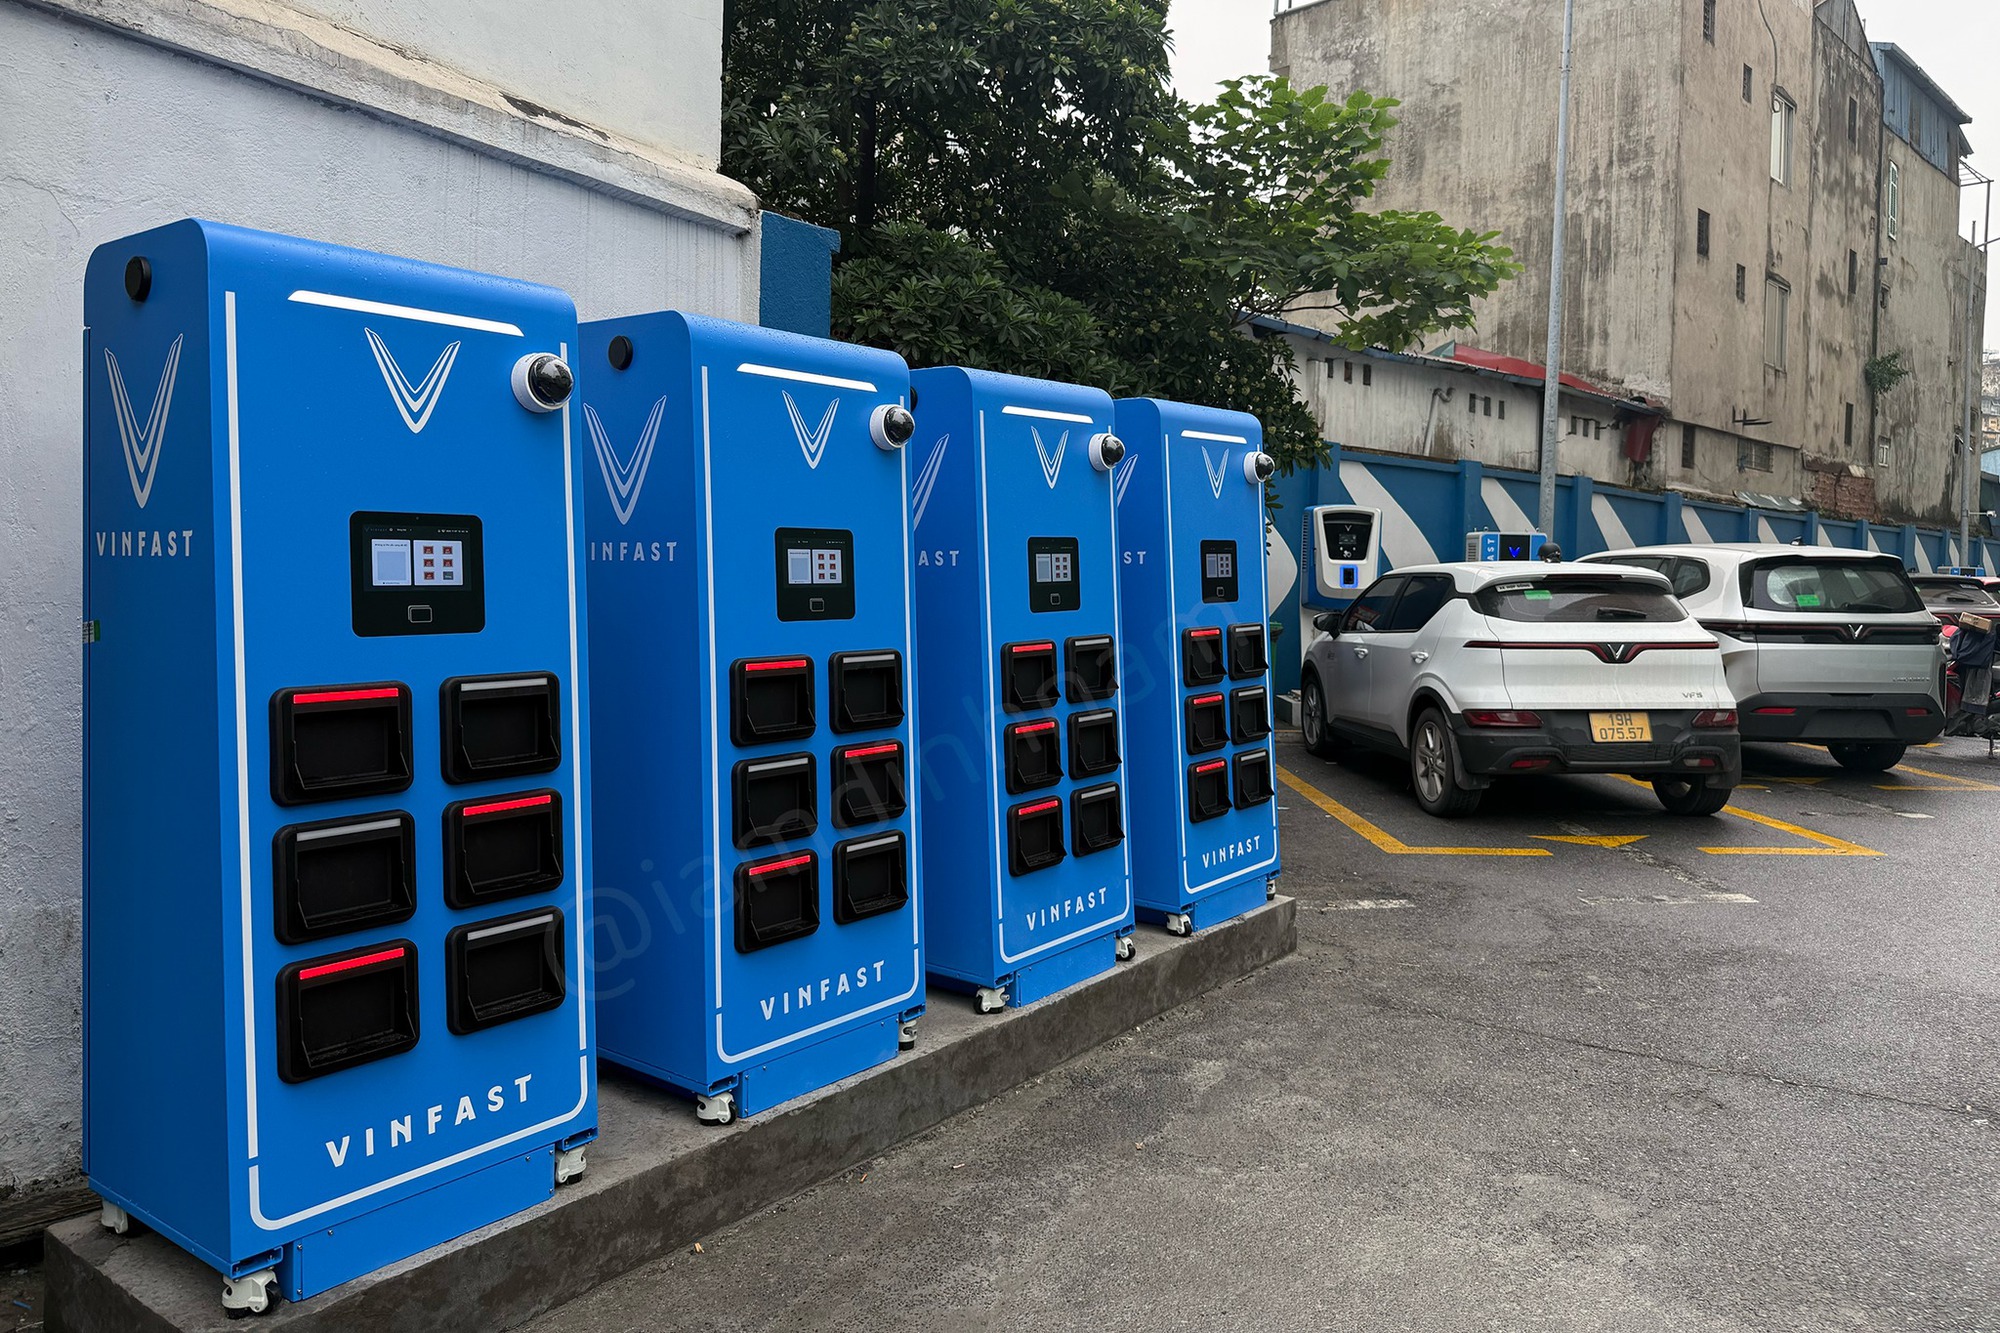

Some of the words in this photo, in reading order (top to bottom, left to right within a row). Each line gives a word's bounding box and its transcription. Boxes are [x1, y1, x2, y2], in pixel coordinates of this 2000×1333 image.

[96, 529, 193, 557] VINFAST
[591, 541, 677, 562] INFAST
[1599, 727, 1644, 740] 075.57
[1608, 712, 1633, 726] 19H
[1201, 834, 1262, 870] VINFAST
[1026, 886, 1109, 932] VINFAST
[759, 959, 887, 1022] VINFAST
[326, 1073, 532, 1169] VINFAST
